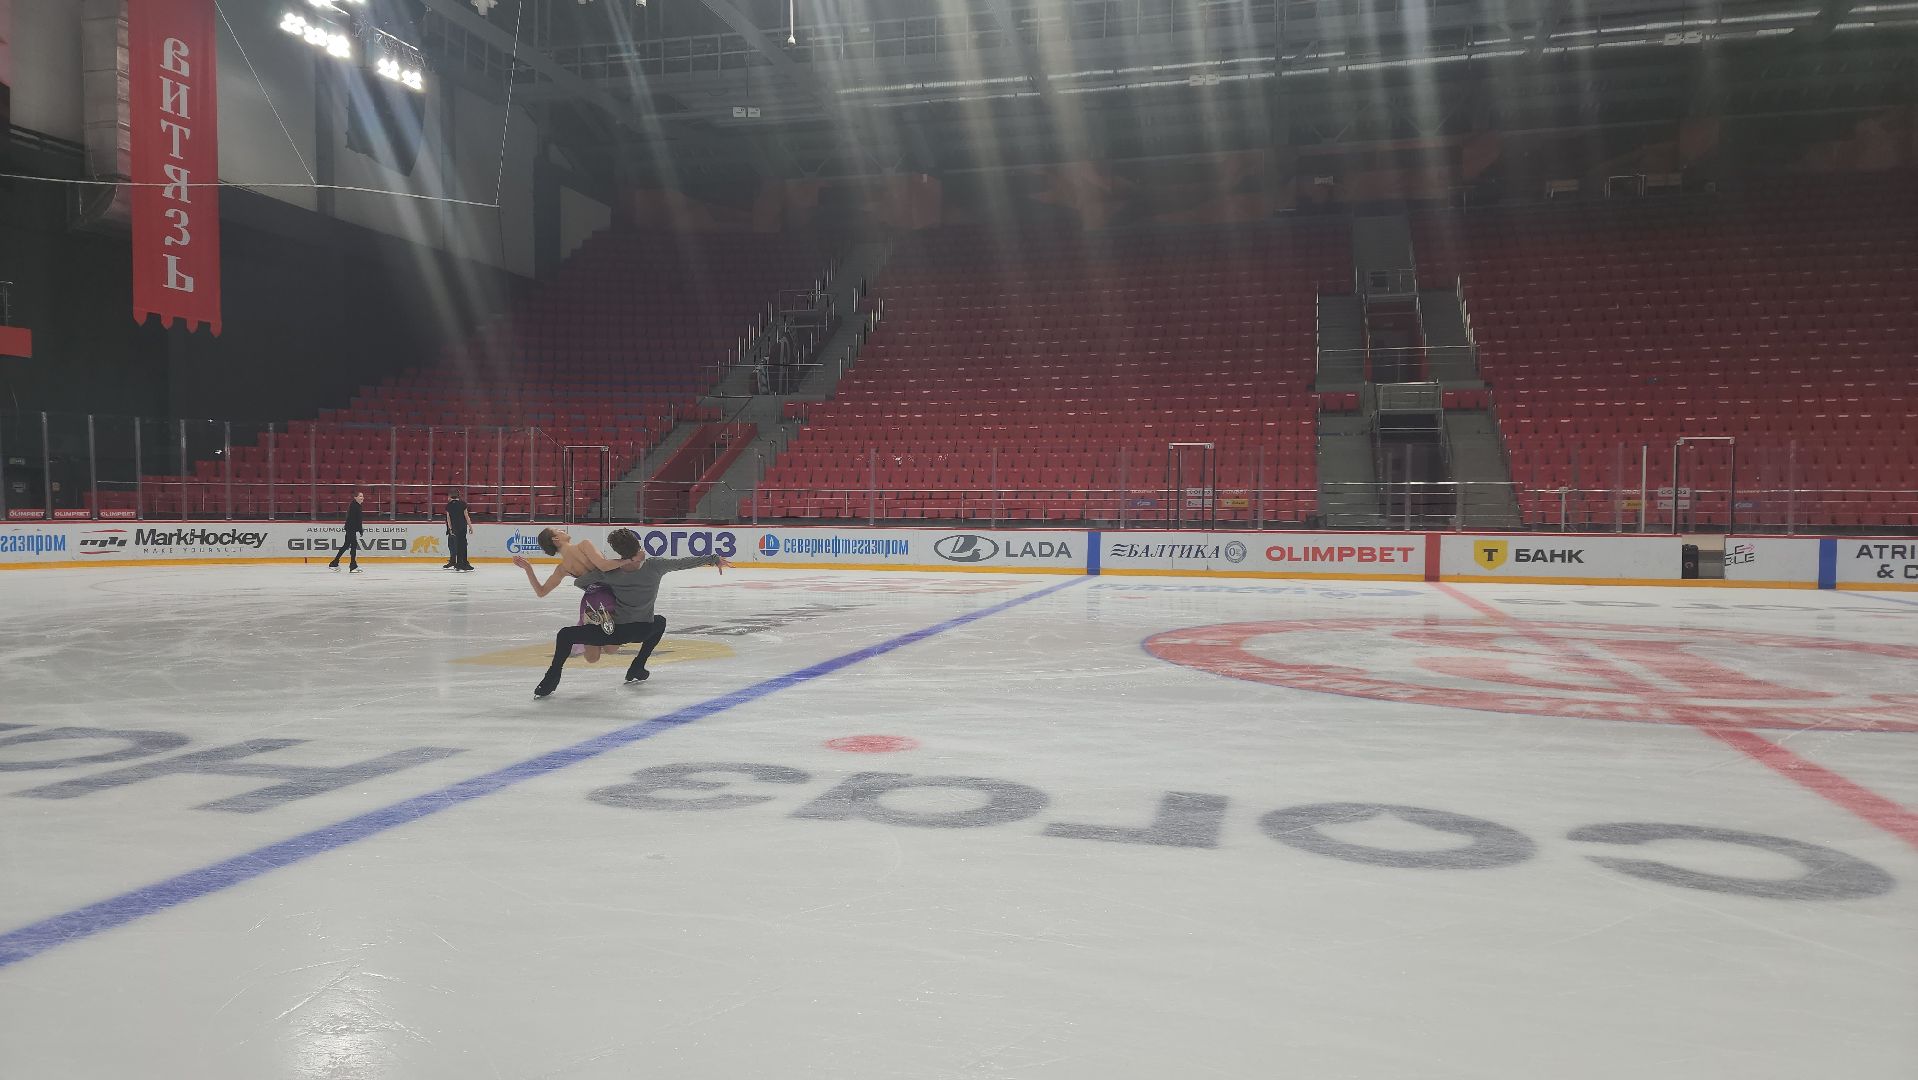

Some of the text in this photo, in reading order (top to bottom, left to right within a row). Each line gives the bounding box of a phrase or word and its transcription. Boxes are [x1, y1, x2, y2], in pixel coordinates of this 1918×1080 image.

[159, 37, 194, 293] ВИТЯЗЬ
[135, 528, 268, 549] MarkHockey
[1006, 540, 1073, 558] LADA
[1126, 543, 1220, 559] БАЛТИКА
[1265, 545, 1415, 563] OLIMPBET
[1514, 548, 1585, 563] БАНК
[1877, 563, 1894, 579] &
